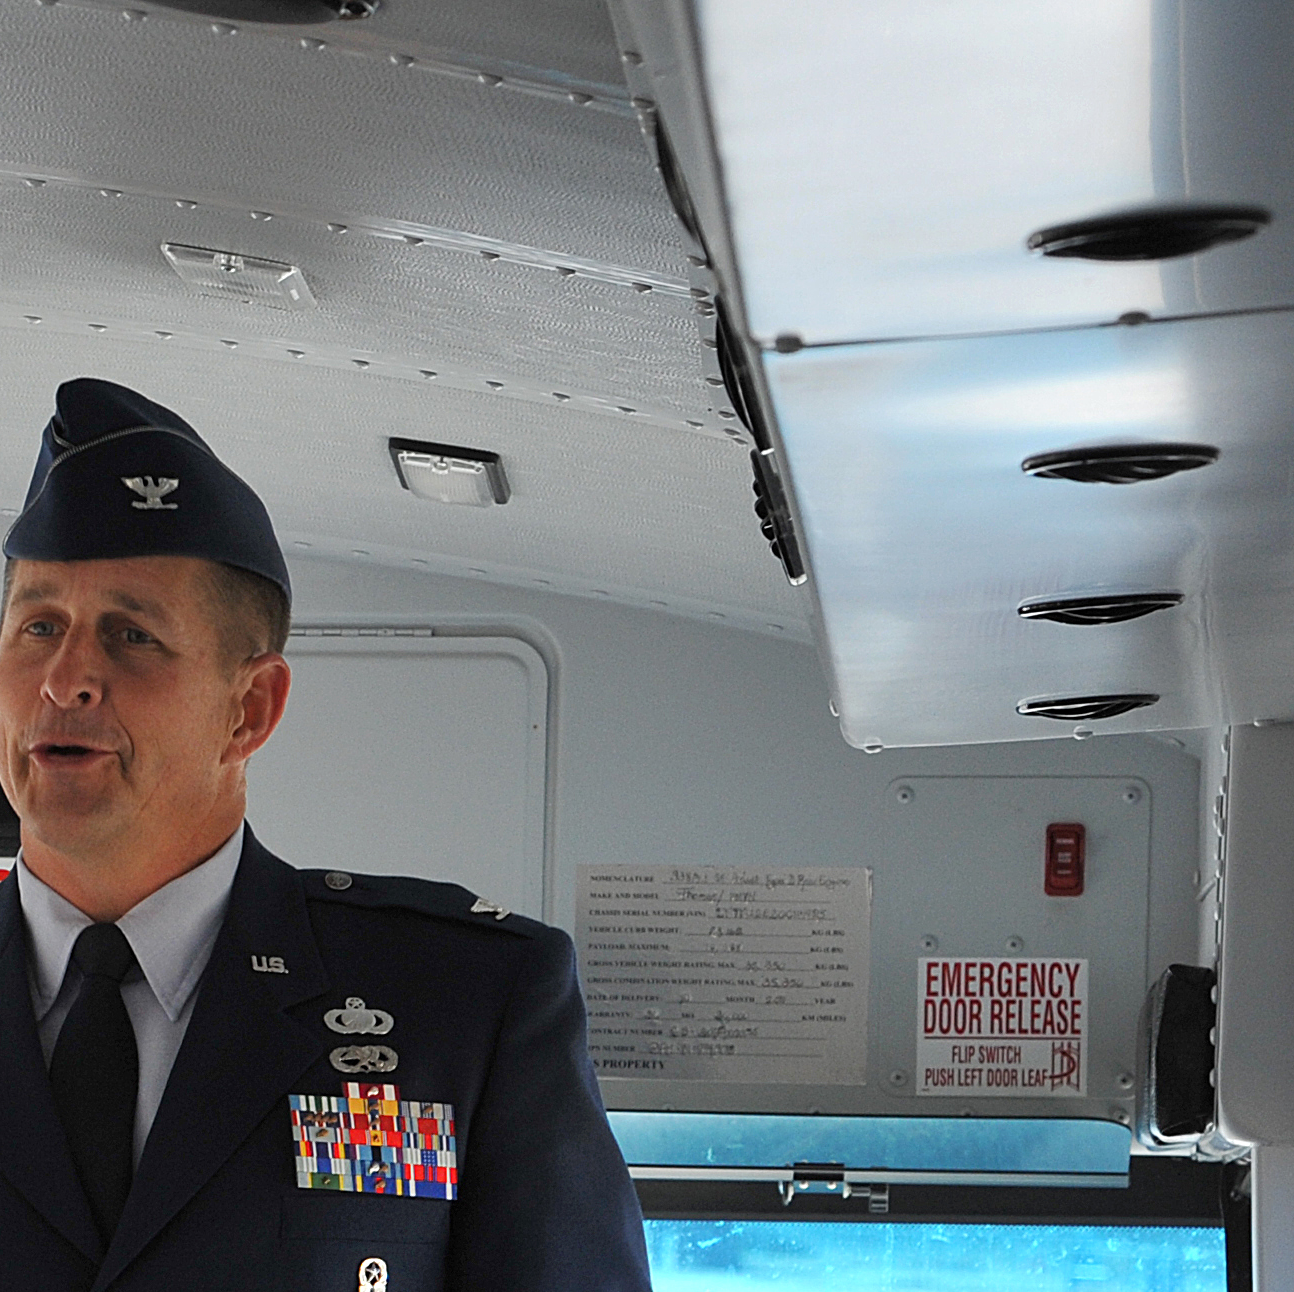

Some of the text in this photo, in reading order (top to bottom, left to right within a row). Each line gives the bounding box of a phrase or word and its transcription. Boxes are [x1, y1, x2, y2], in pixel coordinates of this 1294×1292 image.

[589, 875, 654, 883] NOMENCLATURE
[589, 892, 612, 900] MAKE
[926, 961, 1081, 999] EMERGENCY
[924, 998, 1082, 1035] DOOR RELEASE
[952, 1045, 1022, 1064] FLIP SWITCH
[602, 1059, 665, 1070] PROPERTY
[924, 1068, 1049, 1088] PUSH LEFT DOOR LEAF
